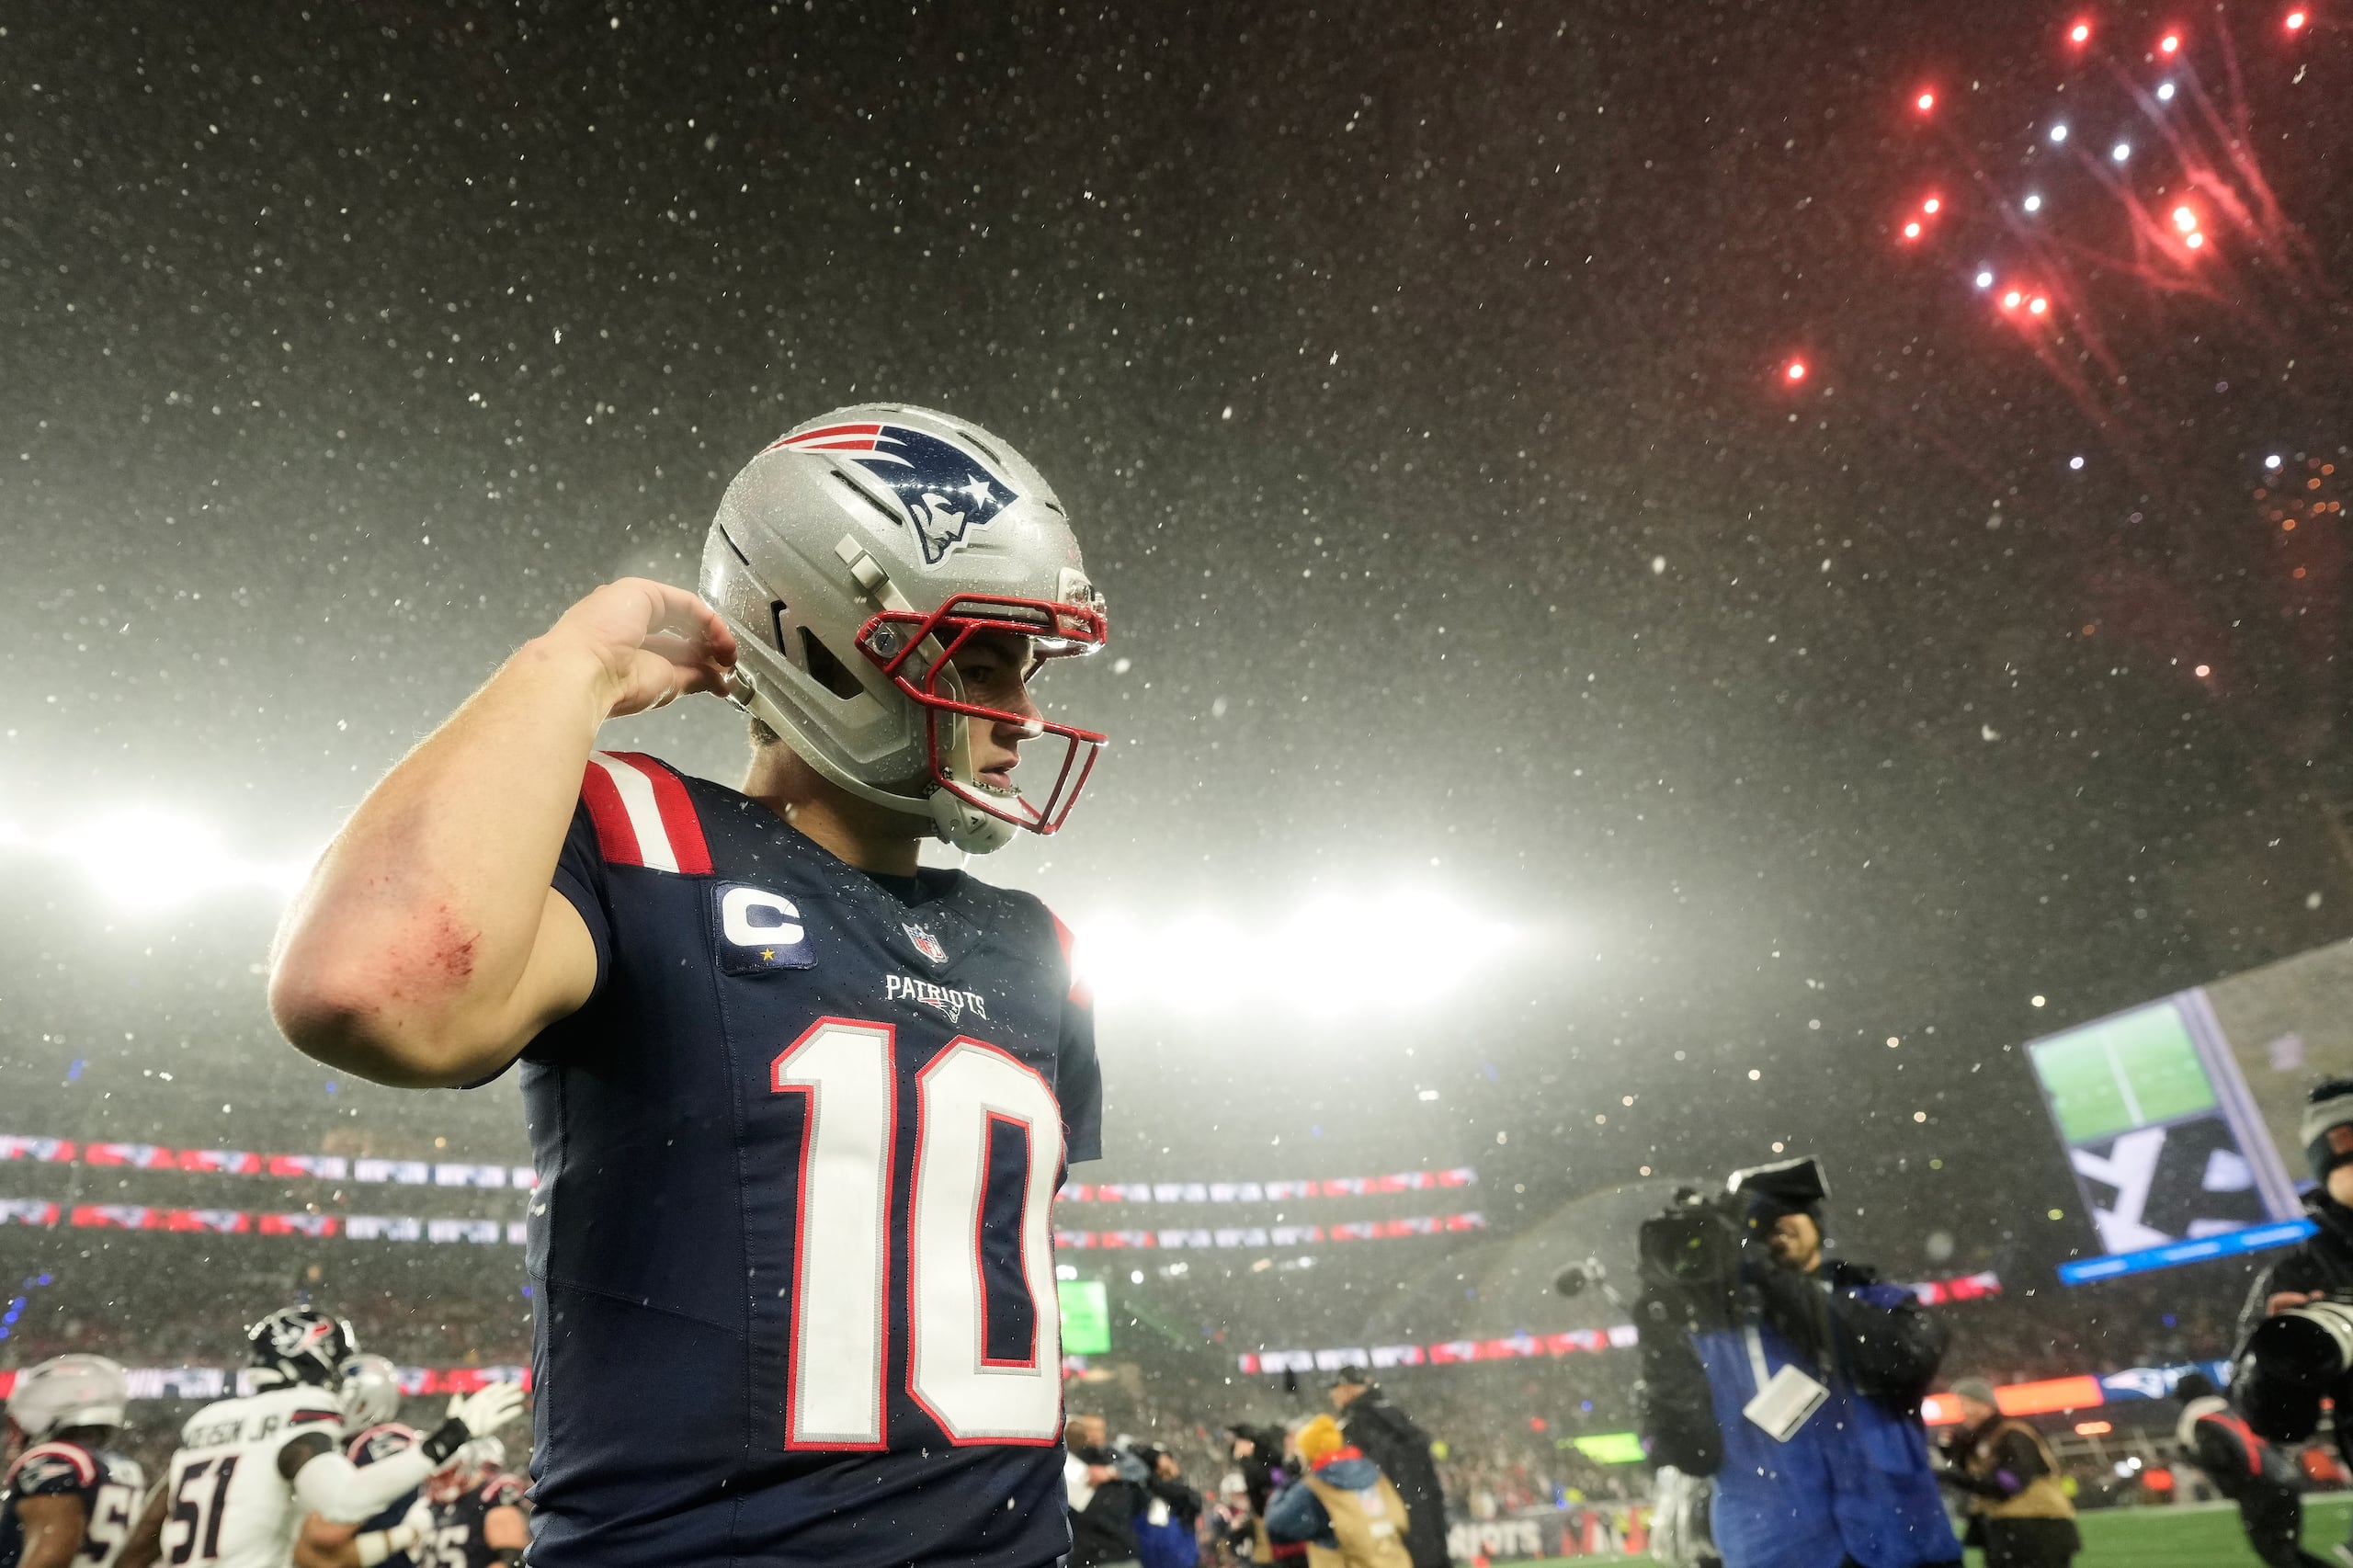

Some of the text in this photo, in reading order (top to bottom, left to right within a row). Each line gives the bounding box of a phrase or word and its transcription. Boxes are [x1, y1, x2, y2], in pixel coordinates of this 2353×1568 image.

[722, 887, 805, 947] C
[886, 974, 987, 1020] PATRIOTS
[769, 1015, 1064, 1455] 10
[170, 1455, 239, 1565] 51
